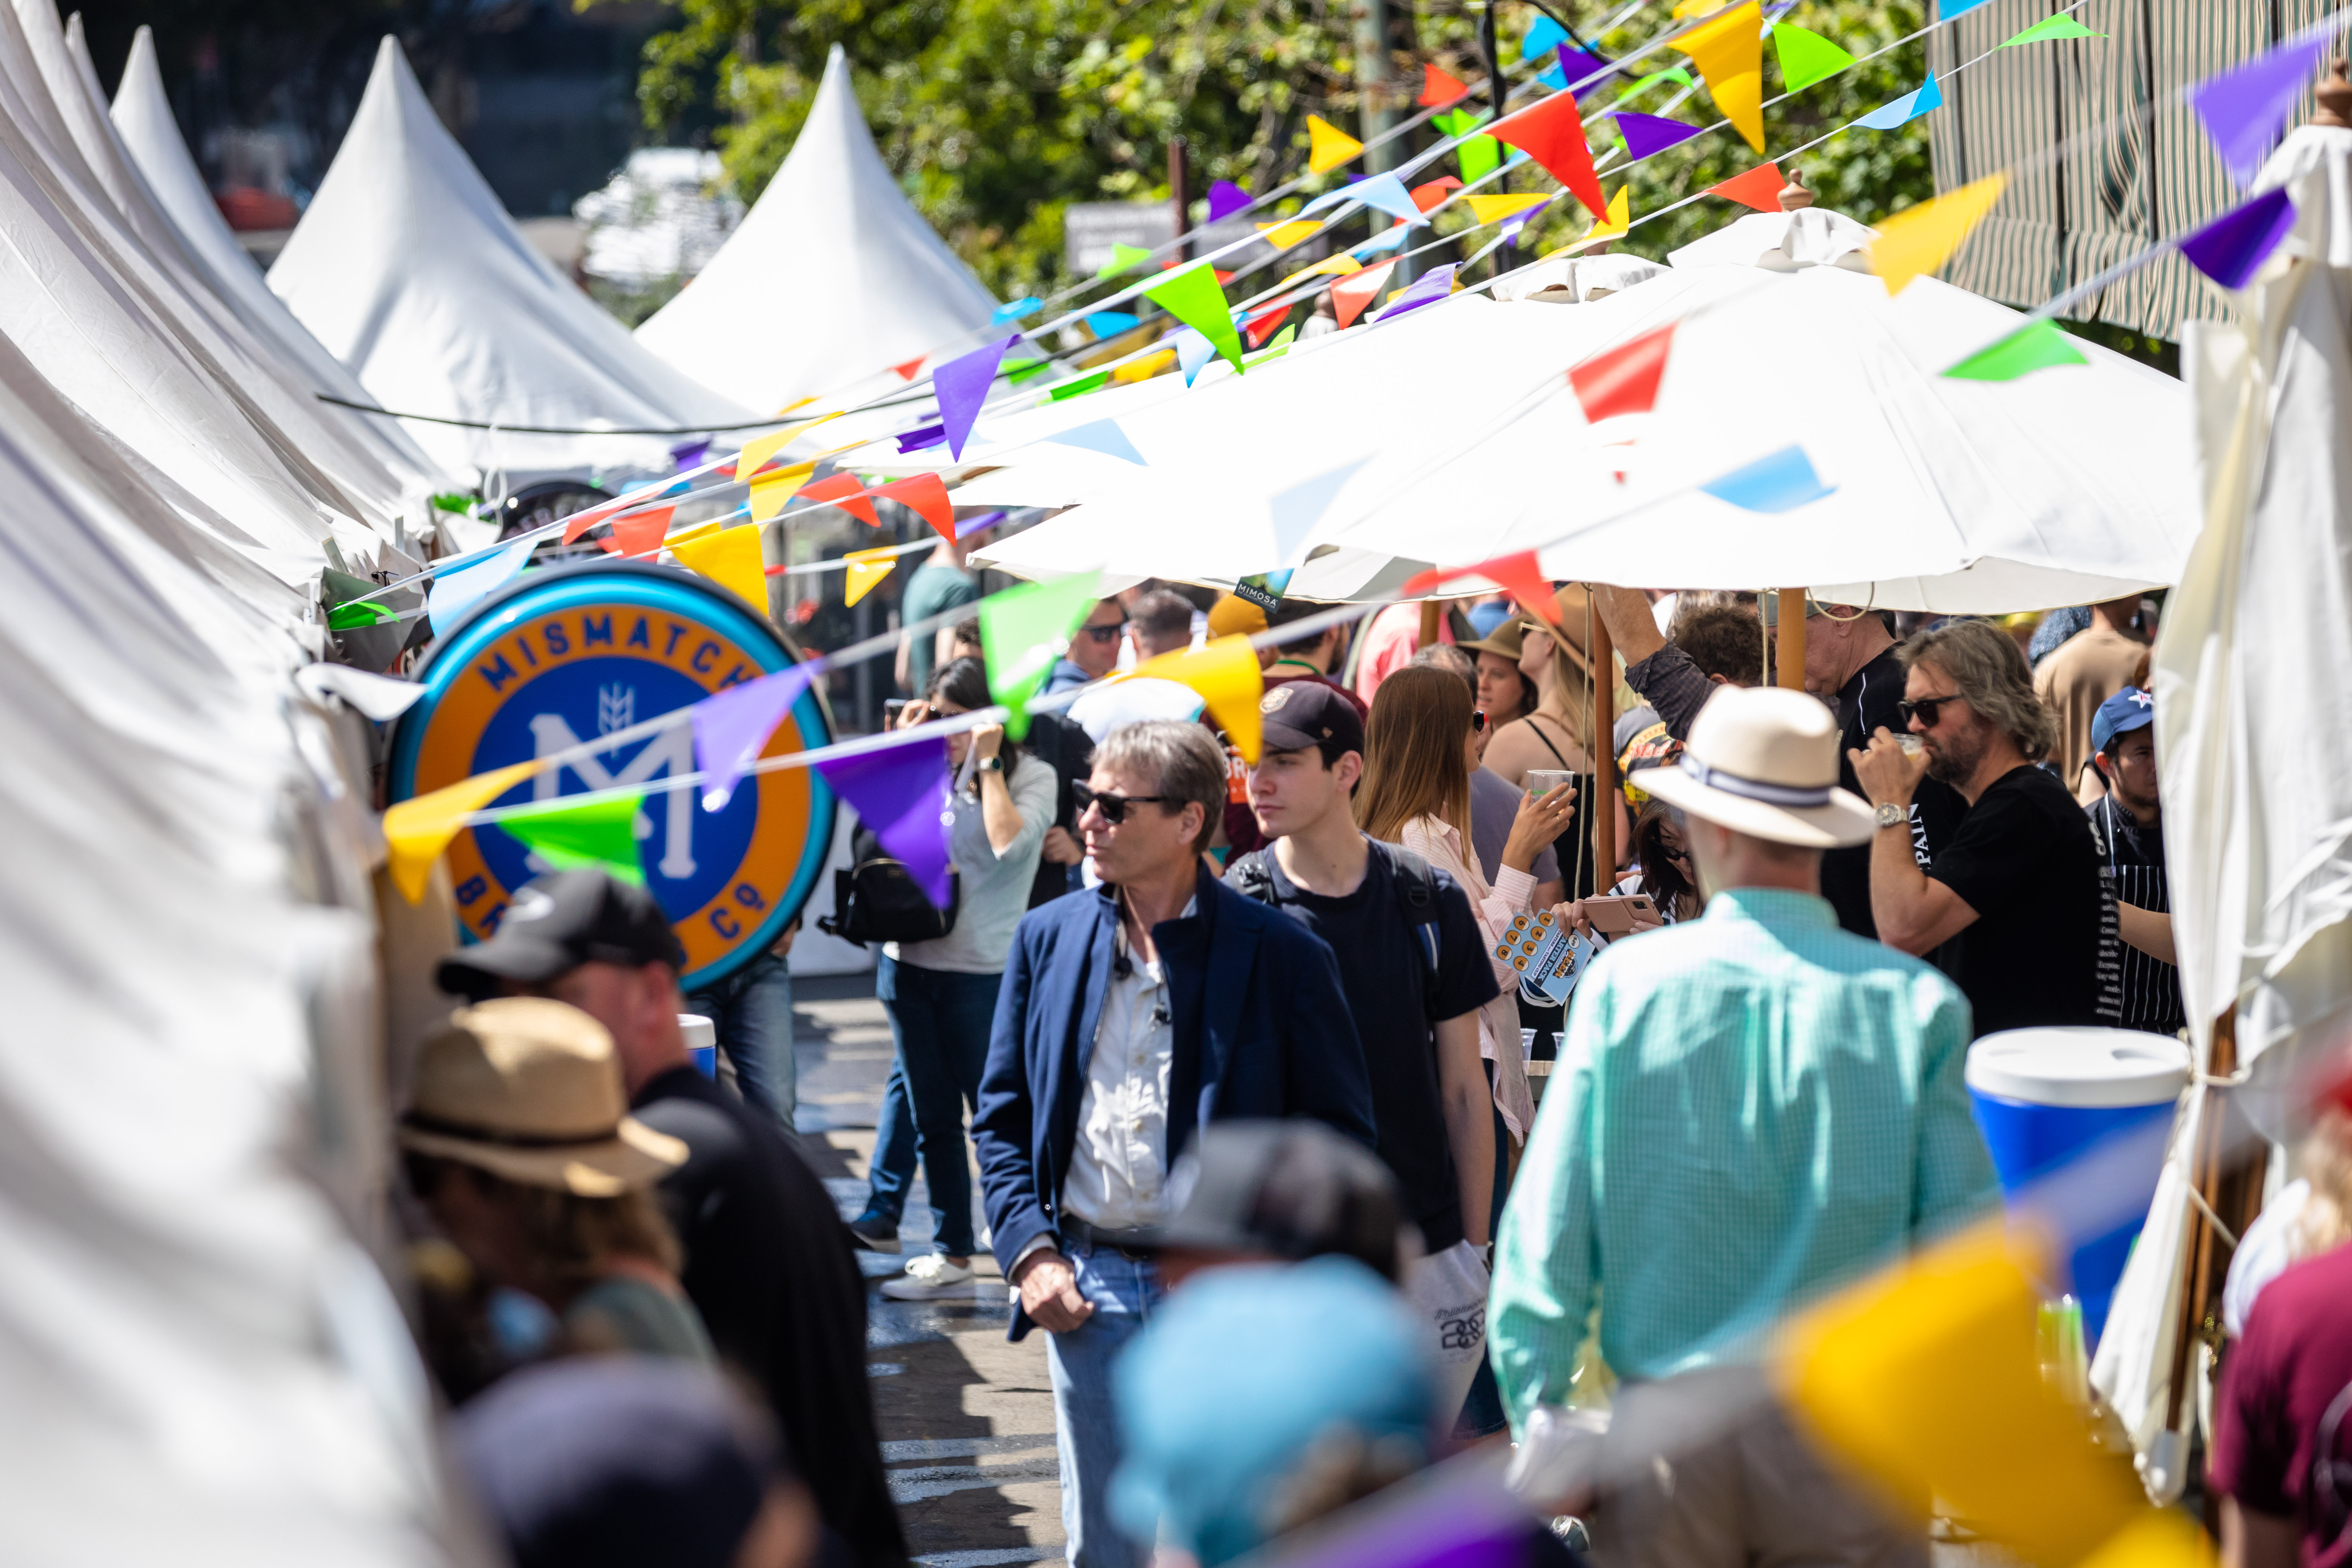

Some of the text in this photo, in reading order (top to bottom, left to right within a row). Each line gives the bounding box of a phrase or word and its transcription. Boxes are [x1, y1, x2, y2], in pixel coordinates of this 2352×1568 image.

[1238, 583, 1276, 606] MIMOSA
[1908, 803, 1931, 869] PAIN
[1550, 930, 1562, 947] TASTERS
[1538, 936, 1568, 981] ARTER PACK
[1538, 951, 1549, 969] TASTING
[1554, 949, 1576, 978] BEER
[1555, 948, 1569, 971] Festival
